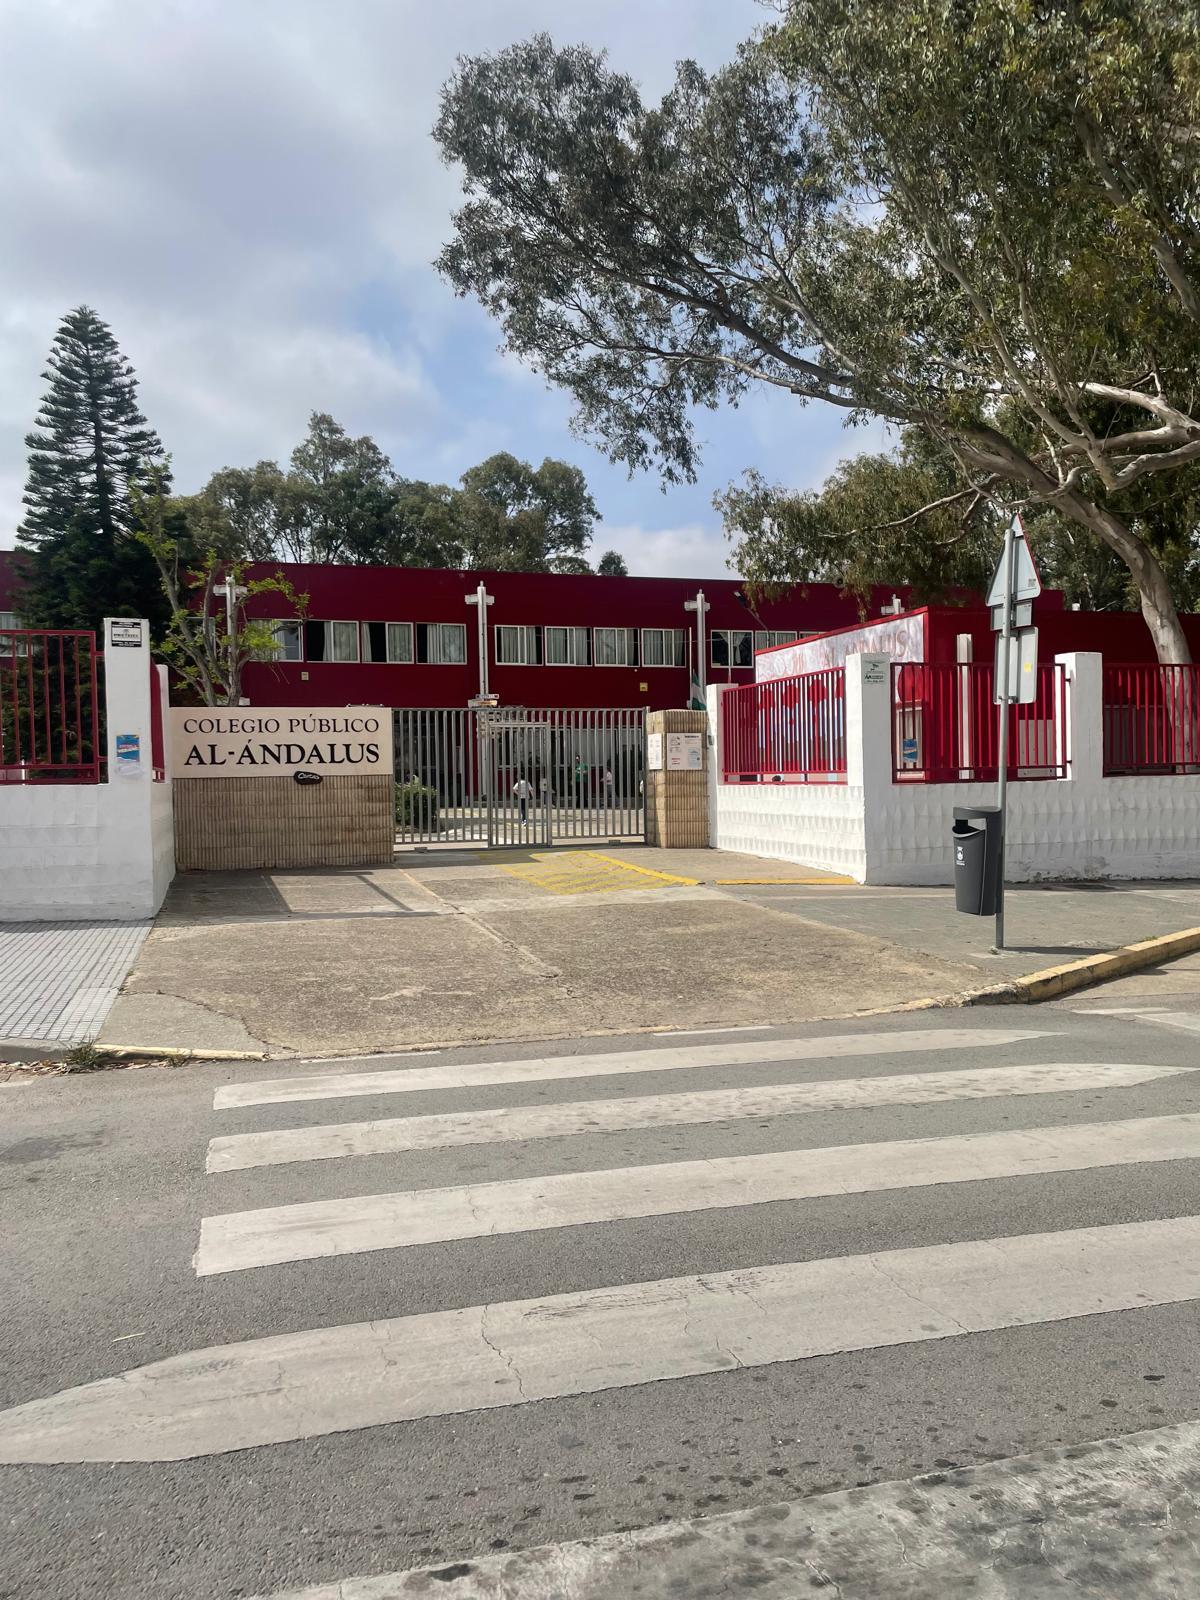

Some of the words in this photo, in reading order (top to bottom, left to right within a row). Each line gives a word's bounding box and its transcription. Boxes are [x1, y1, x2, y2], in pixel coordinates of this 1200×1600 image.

[183, 718, 280, 734] COLEGIO
[288, 713, 379, 734] PÚBLICO
[184, 739, 380, 766] AL-ÁNDALUS
